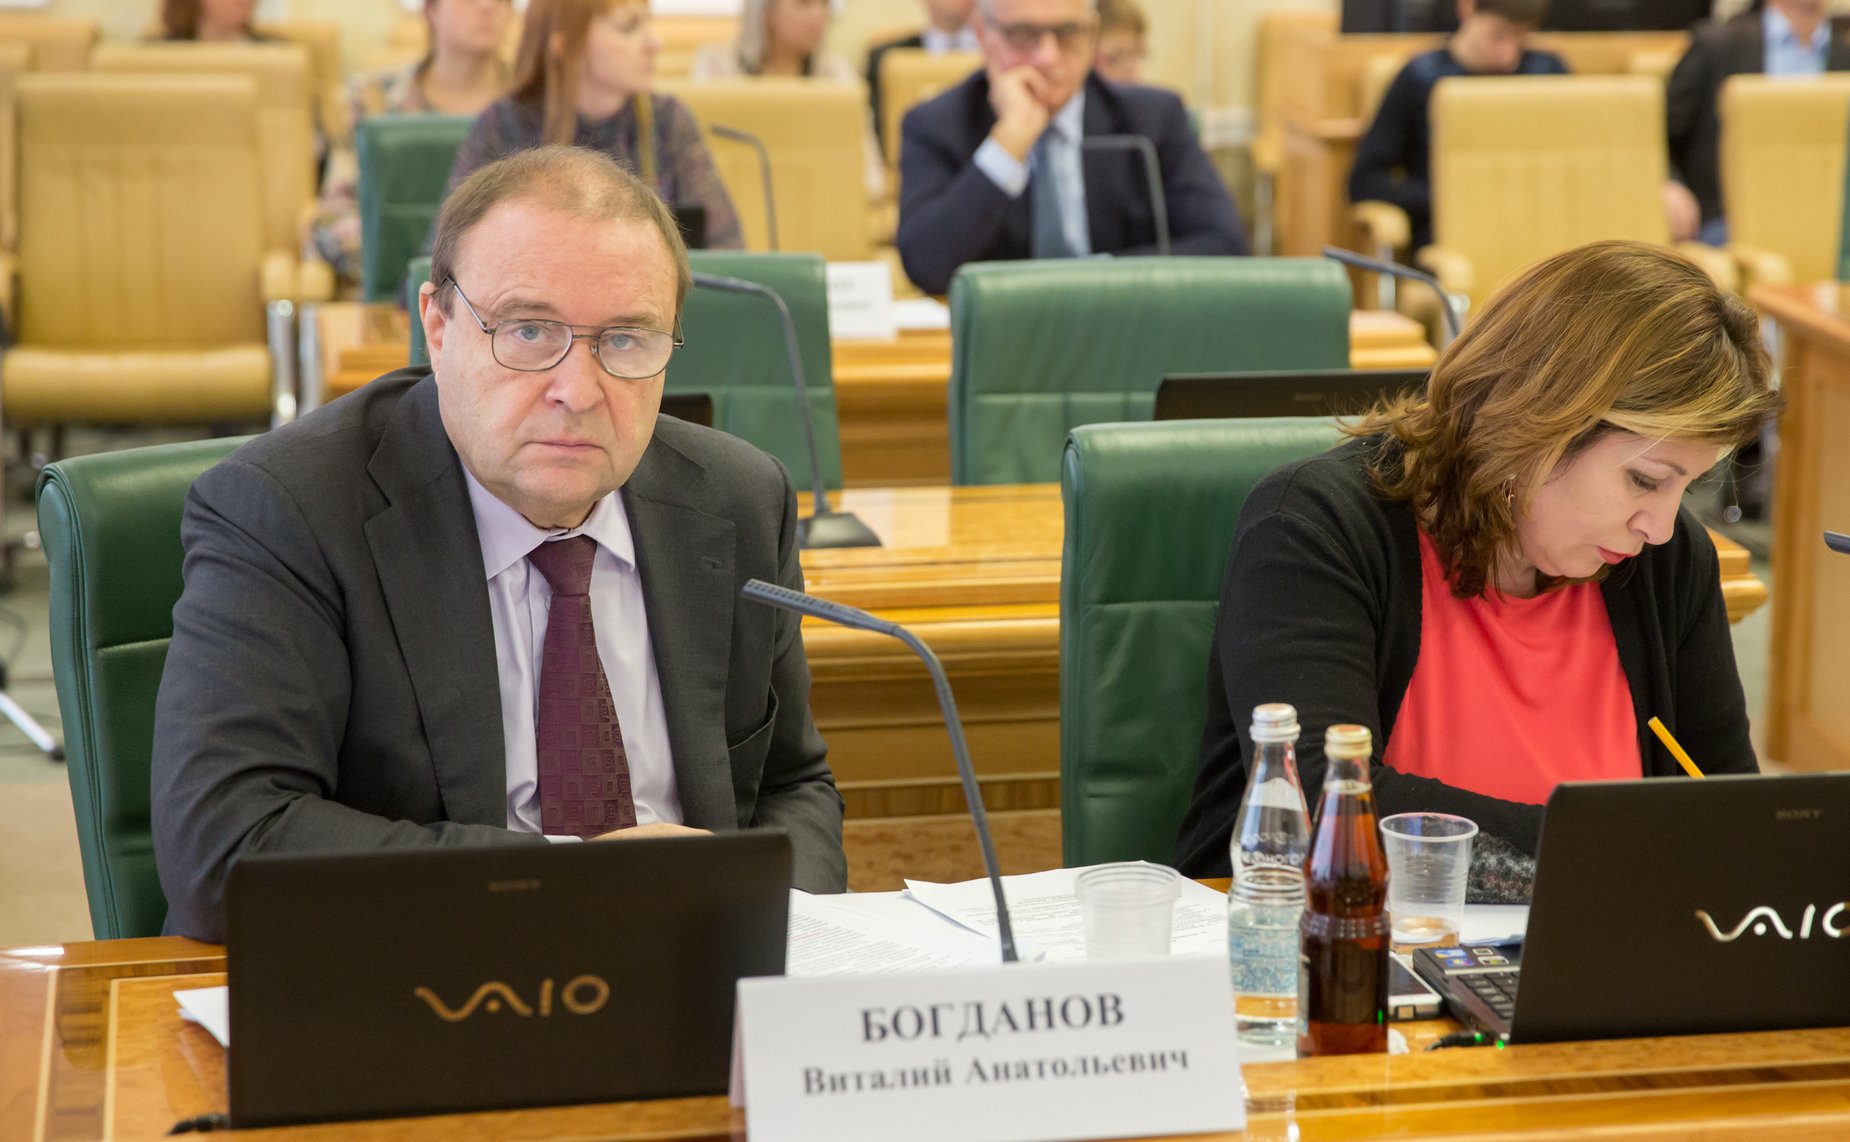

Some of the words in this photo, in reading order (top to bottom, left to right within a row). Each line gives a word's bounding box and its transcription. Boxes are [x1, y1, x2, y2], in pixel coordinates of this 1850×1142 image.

[1695, 901, 1850, 942] VAIO
[414, 974, 610, 1022] VAIO
[860, 992, 1125, 1043] БОГДАНОВ
[803, 1058, 952, 1096] Виталий
[966, 1049, 1189, 1085] Анатольевич
